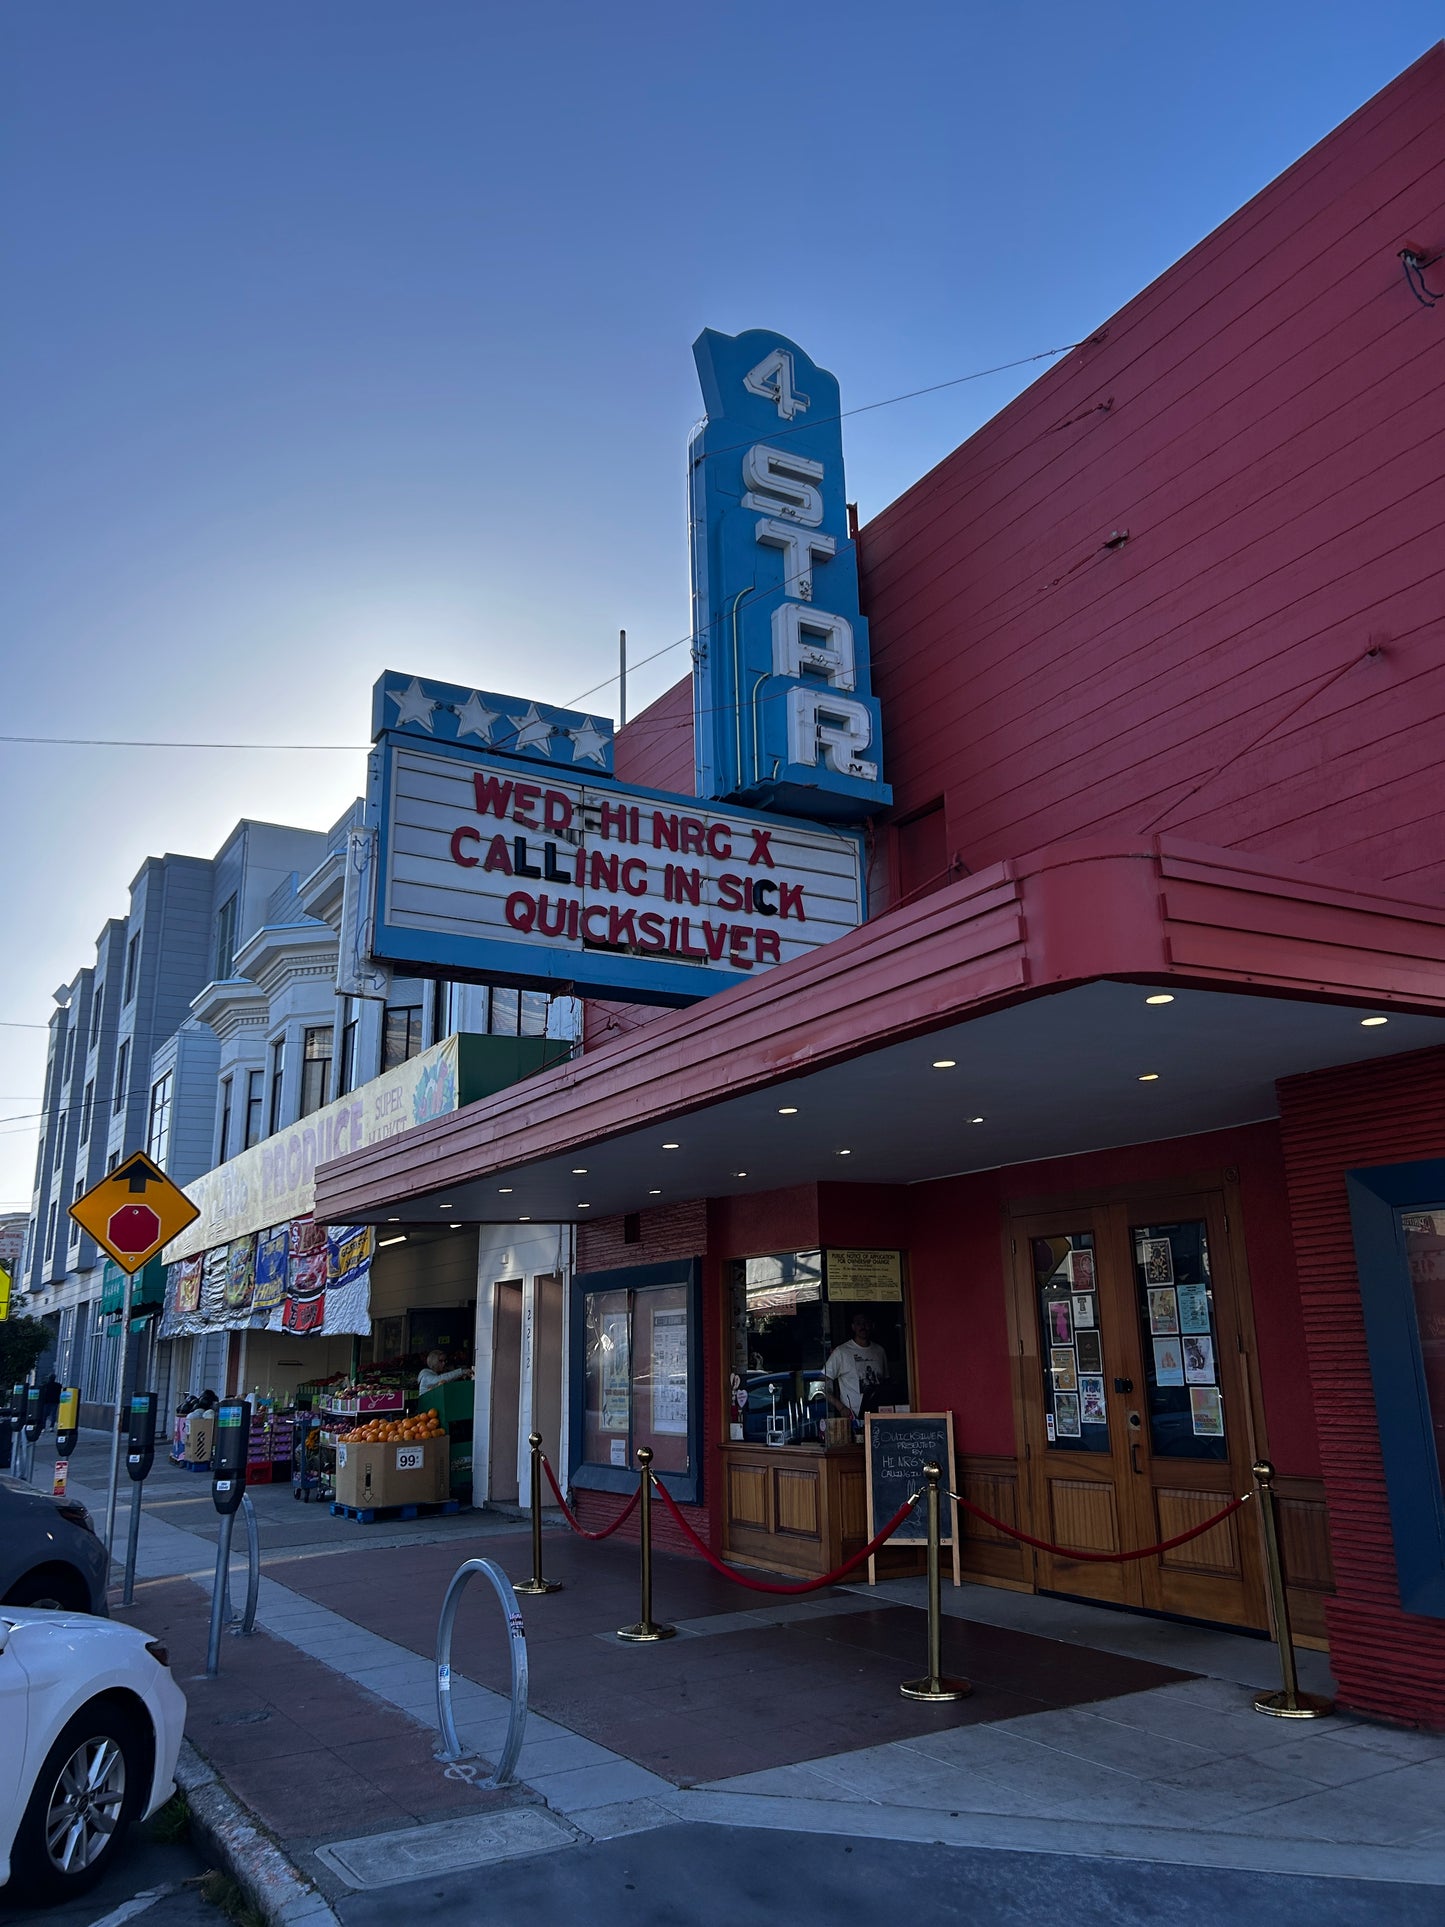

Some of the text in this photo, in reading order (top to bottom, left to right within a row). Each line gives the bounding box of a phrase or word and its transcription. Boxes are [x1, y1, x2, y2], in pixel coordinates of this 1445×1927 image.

[743, 347, 811, 422] 4
[741, 443, 879, 782] STAR
[474, 772, 775, 869] WED HI NRG X
[450, 825, 806, 922] CALLING IN SICK
[504, 890, 781, 970] QUICKSILVER
[375, 1086, 403, 1121] SUPER
[262, 1101, 363, 1202] PRODUCE
[882, 1455, 895, 1468] HI
